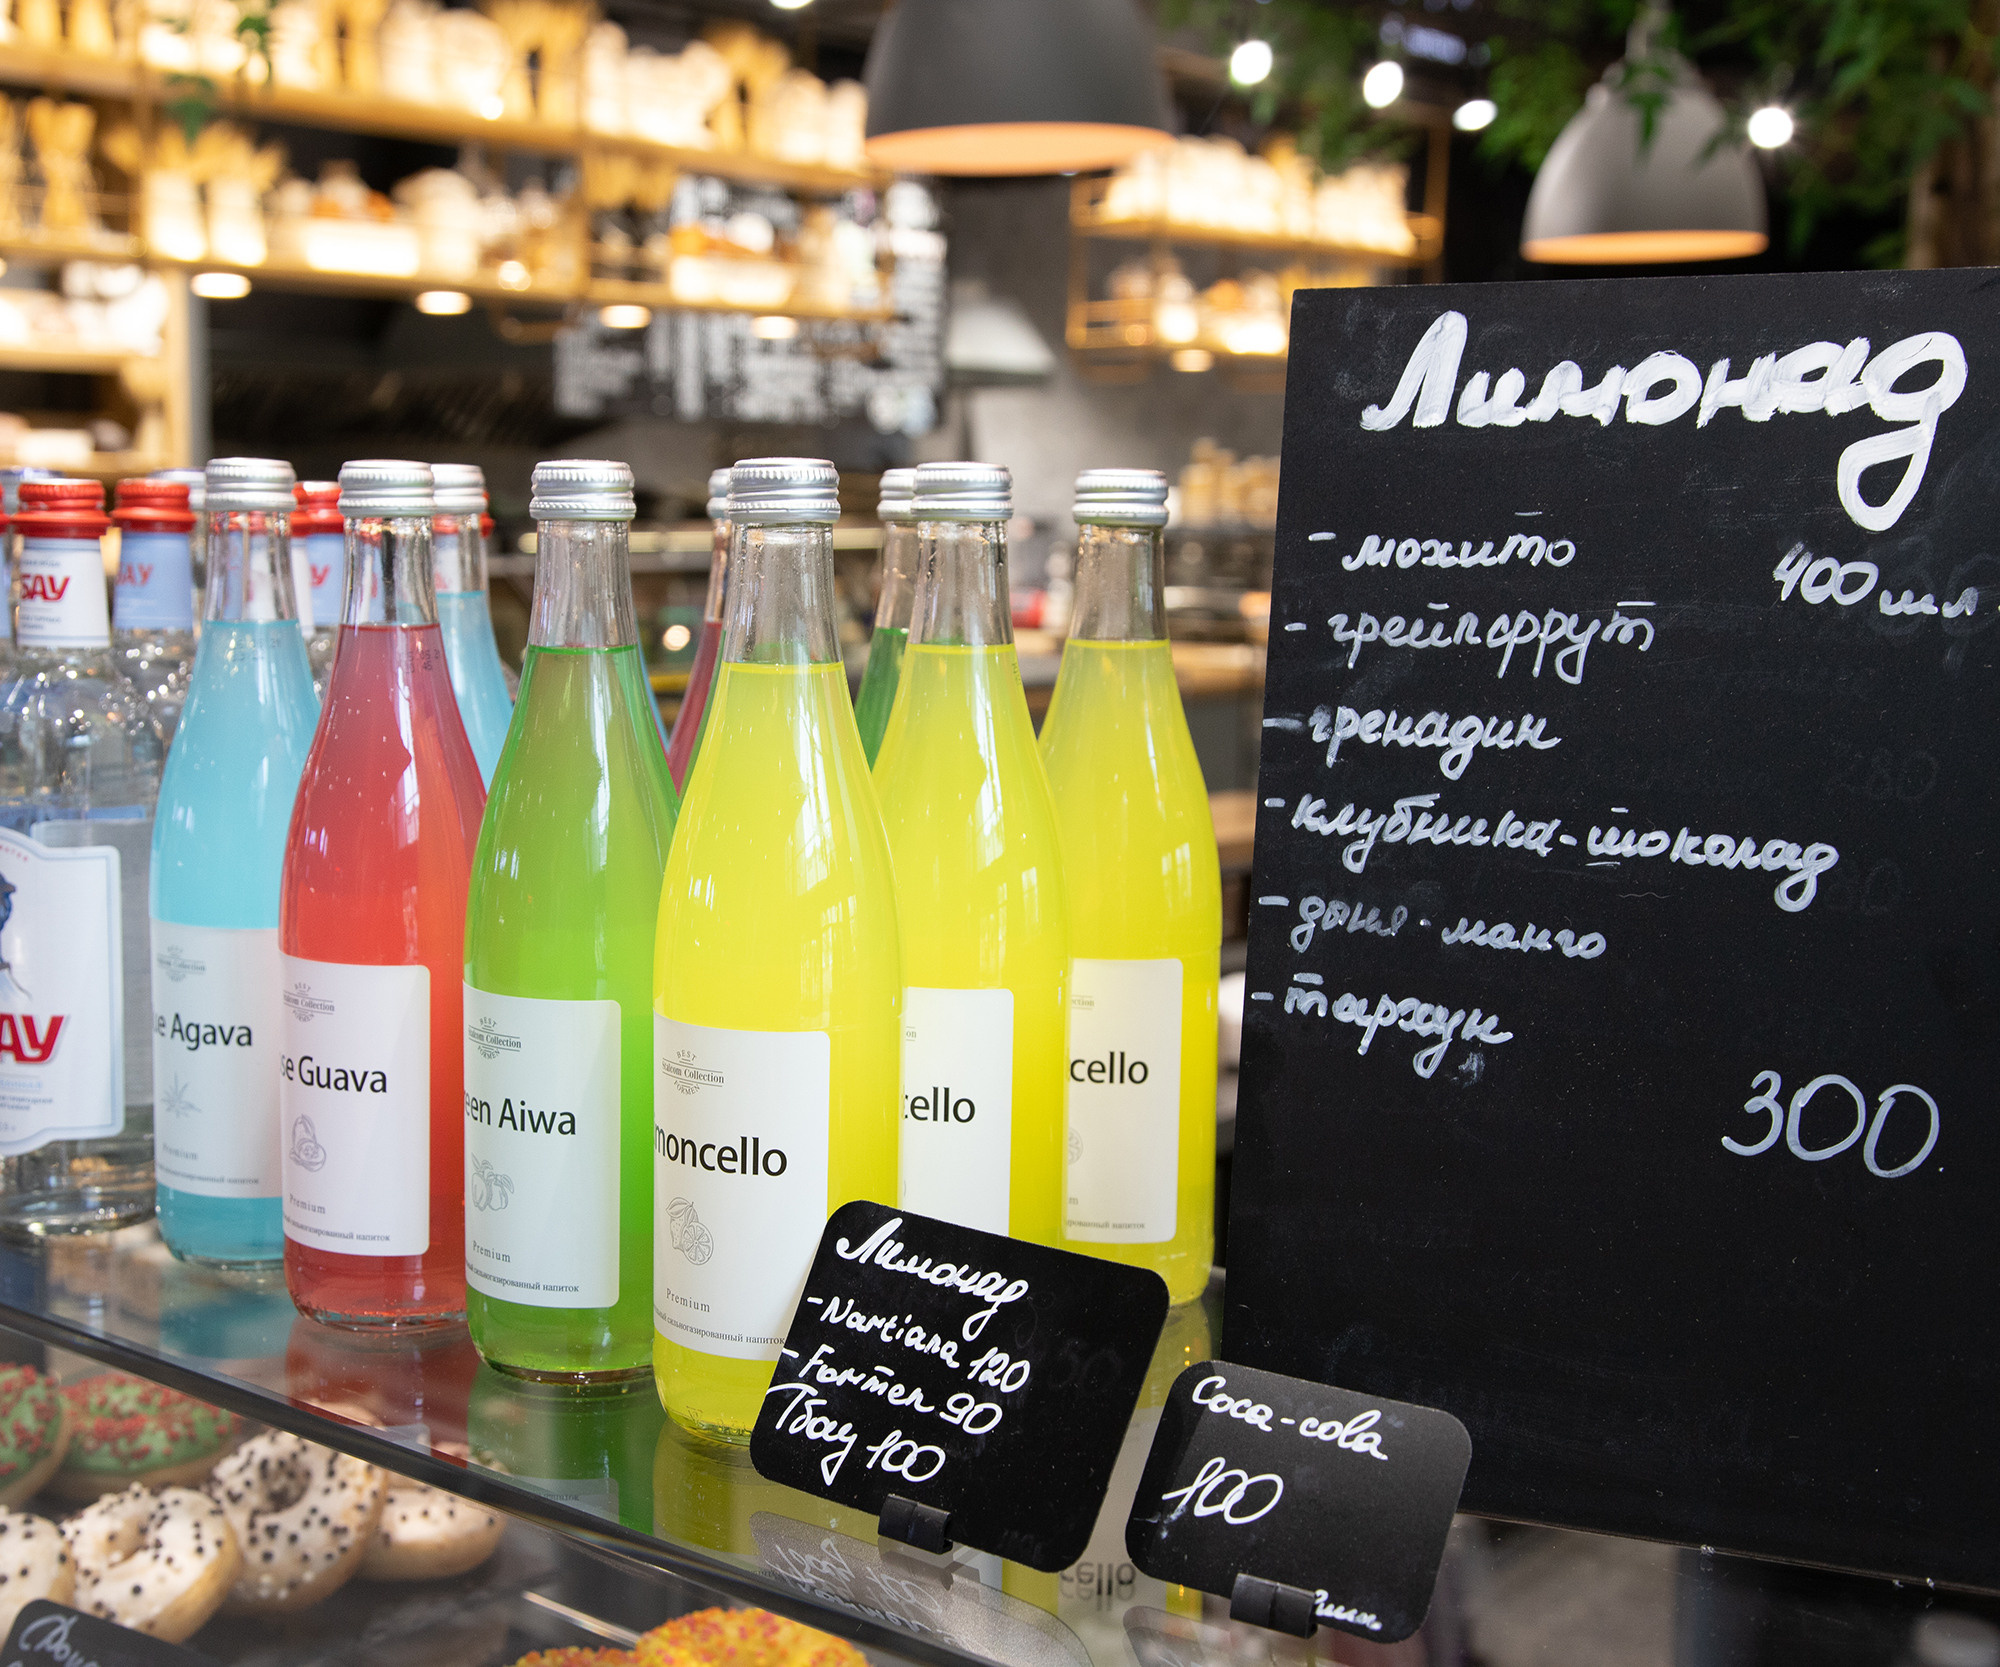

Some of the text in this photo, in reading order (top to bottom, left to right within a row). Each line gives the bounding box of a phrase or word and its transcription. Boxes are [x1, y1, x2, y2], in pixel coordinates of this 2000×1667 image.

[1360, 310, 1969, 532] Лимонад
[300, 999, 336, 1013] Collection
[478, 1016, 498, 1028] BEST
[0, 1013, 64, 1064] АУ
[170, 1012, 253, 1052] Agava
[485, 1033, 522, 1049] Collection
[280, 1054, 388, 1094] se Guava
[676, 1049, 697, 1061] BEST
[673, 1080, 701, 1096] FORMEN
[684, 1067, 725, 1084] Collection
[463, 1090, 577, 1136] een Aiwa
[1721, 1070, 1940, 1179] 300
[653, 1122, 788, 1177] moncello
[472, 1239, 511, 1263] Premium
[542, 1284, 580, 1293] напиток
[836, 1217, 1029, 1342] Лимонад
[665, 1287, 711, 1313] Premium
[745, 1335, 785, 1345] напиток
[967, 1347, 1031, 1393] 120
[939, 1392, 1003, 1435] 90
[1191, 1374, 1389, 1461] Coca-cola
[866, 1429, 946, 1483] 100
[1161, 1456, 1285, 1526] 100
